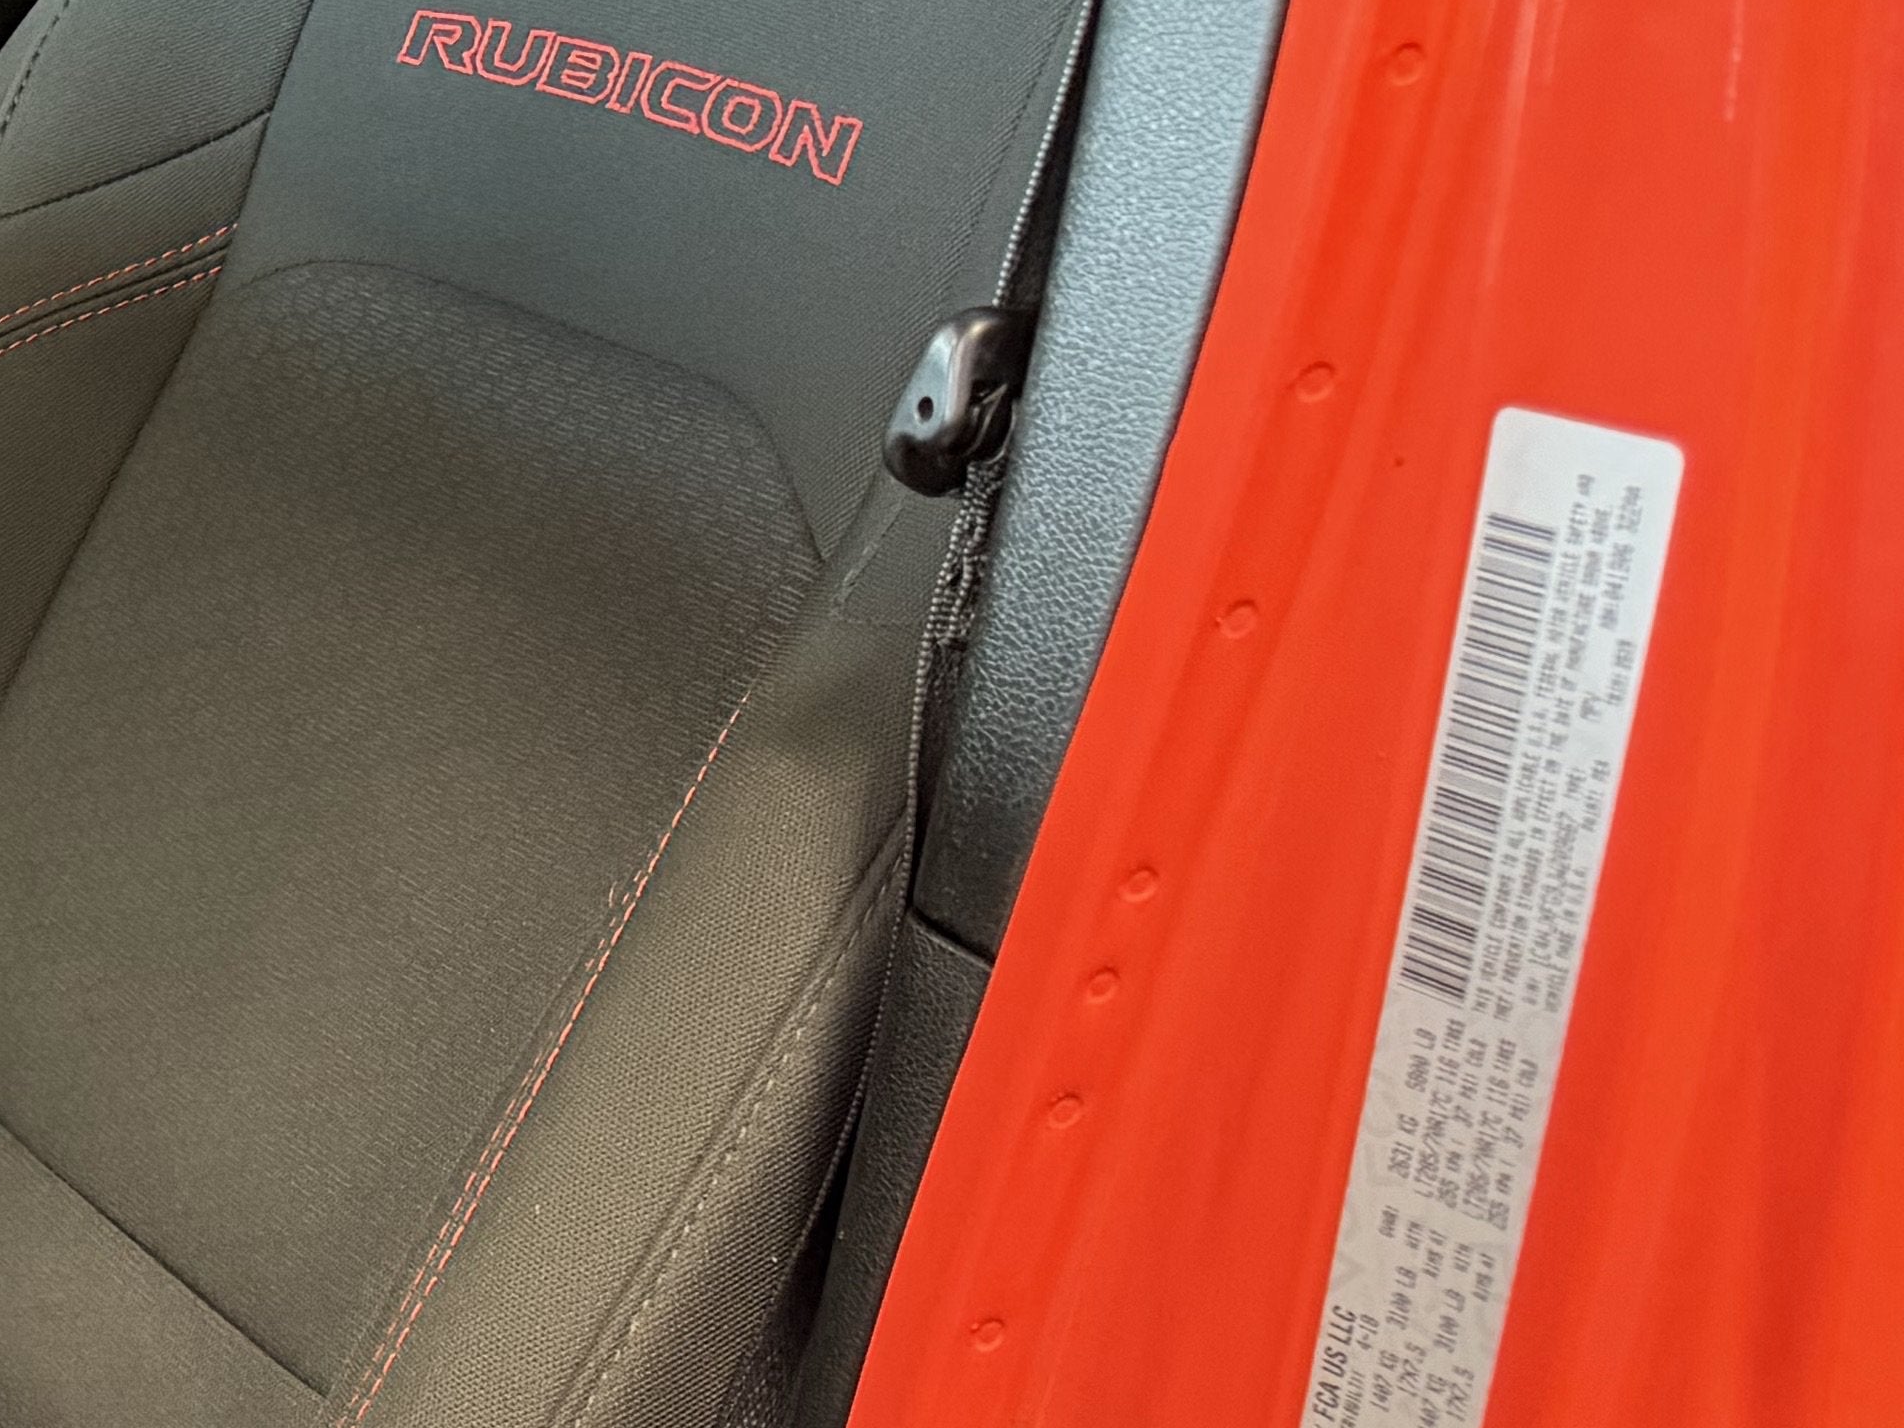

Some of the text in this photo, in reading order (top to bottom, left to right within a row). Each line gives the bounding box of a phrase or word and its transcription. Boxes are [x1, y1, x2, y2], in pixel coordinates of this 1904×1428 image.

[396, 10, 863, 186] RUBICON
[1411, 1025, 1437, 1052] LB
[1395, 1110, 1420, 1137] KG
[1386, 1138, 1414, 1180] 2631
[1485, 1197, 1511, 1232] 255
[1500, 1123, 1526, 1149] 37
[1395, 1338, 1427, 1399] 17X7.5
[1435, 1174, 1461, 1210] 255
[1451, 1103, 1476, 1128] 37
[1393, 1262, 1418, 1291] LB
[1384, 1288, 1413, 1332] 3100
[1440, 1284, 1466, 1314] LB
[1326, 1301, 1357, 1348] LLC
[1431, 1310, 1460, 1355] 3100
[1320, 1342, 1348, 1379] US
[1377, 1346, 1400, 1374] KG
[1311, 1374, 1342, 1423] FCA
[1368, 1371, 1395, 1413] 1407
[1424, 1370, 1449, 1398] KG
